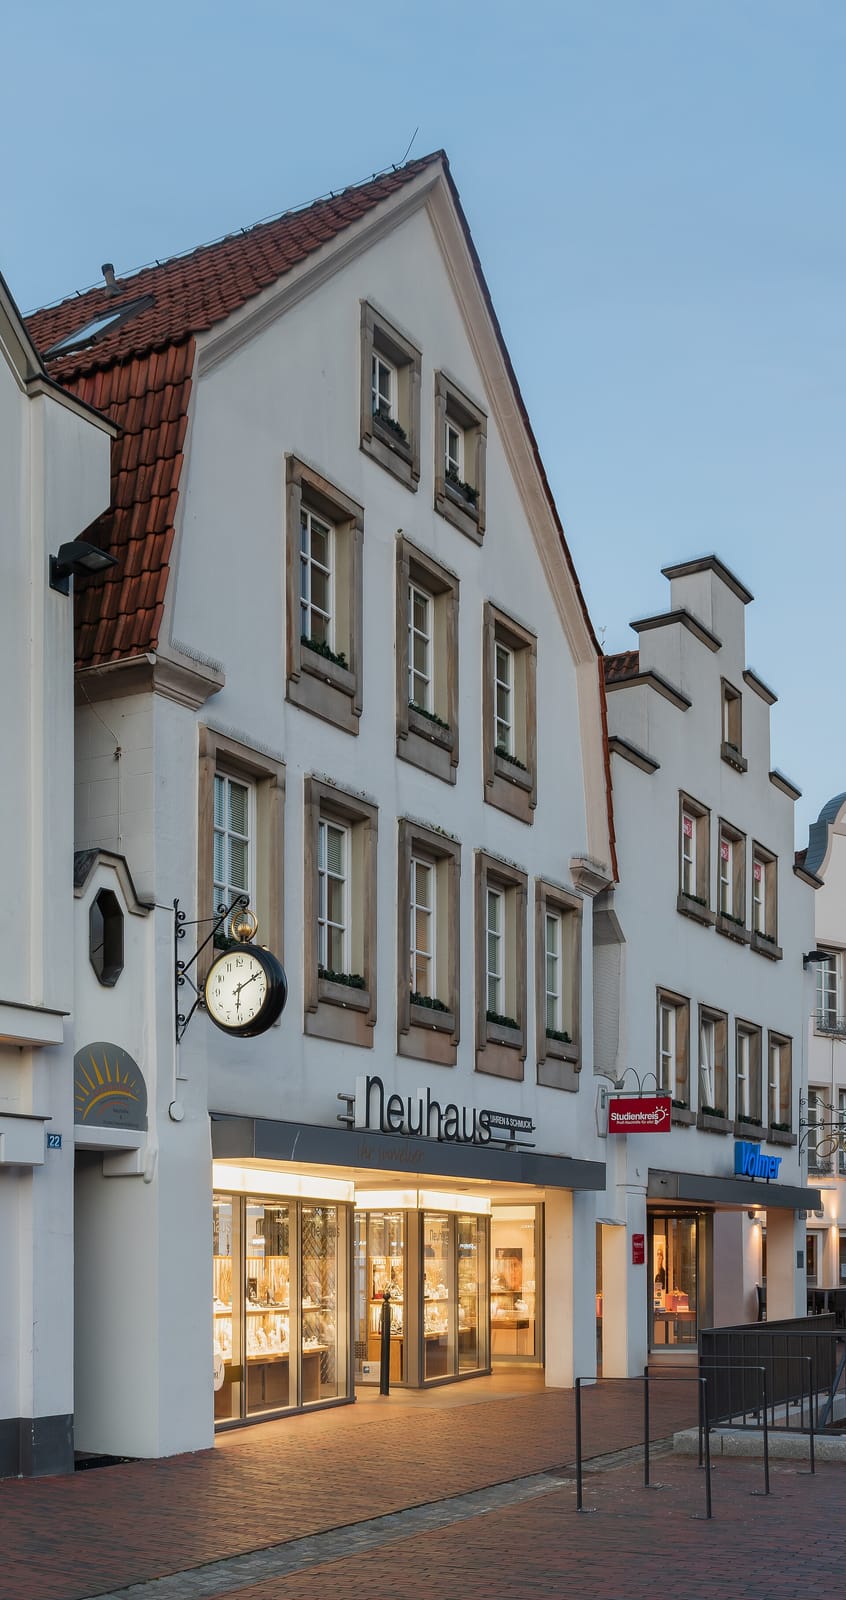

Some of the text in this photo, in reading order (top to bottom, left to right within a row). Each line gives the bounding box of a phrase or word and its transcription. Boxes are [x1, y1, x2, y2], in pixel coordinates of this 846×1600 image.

[489, 1114, 505, 1126] UHREN
[510, 1118, 532, 1129] SCHMUCK
[611, 1111, 659, 1121] Studienkreis
[49, 1135, 61, 1147] 22
[742, 1141, 782, 1179] Volmer
